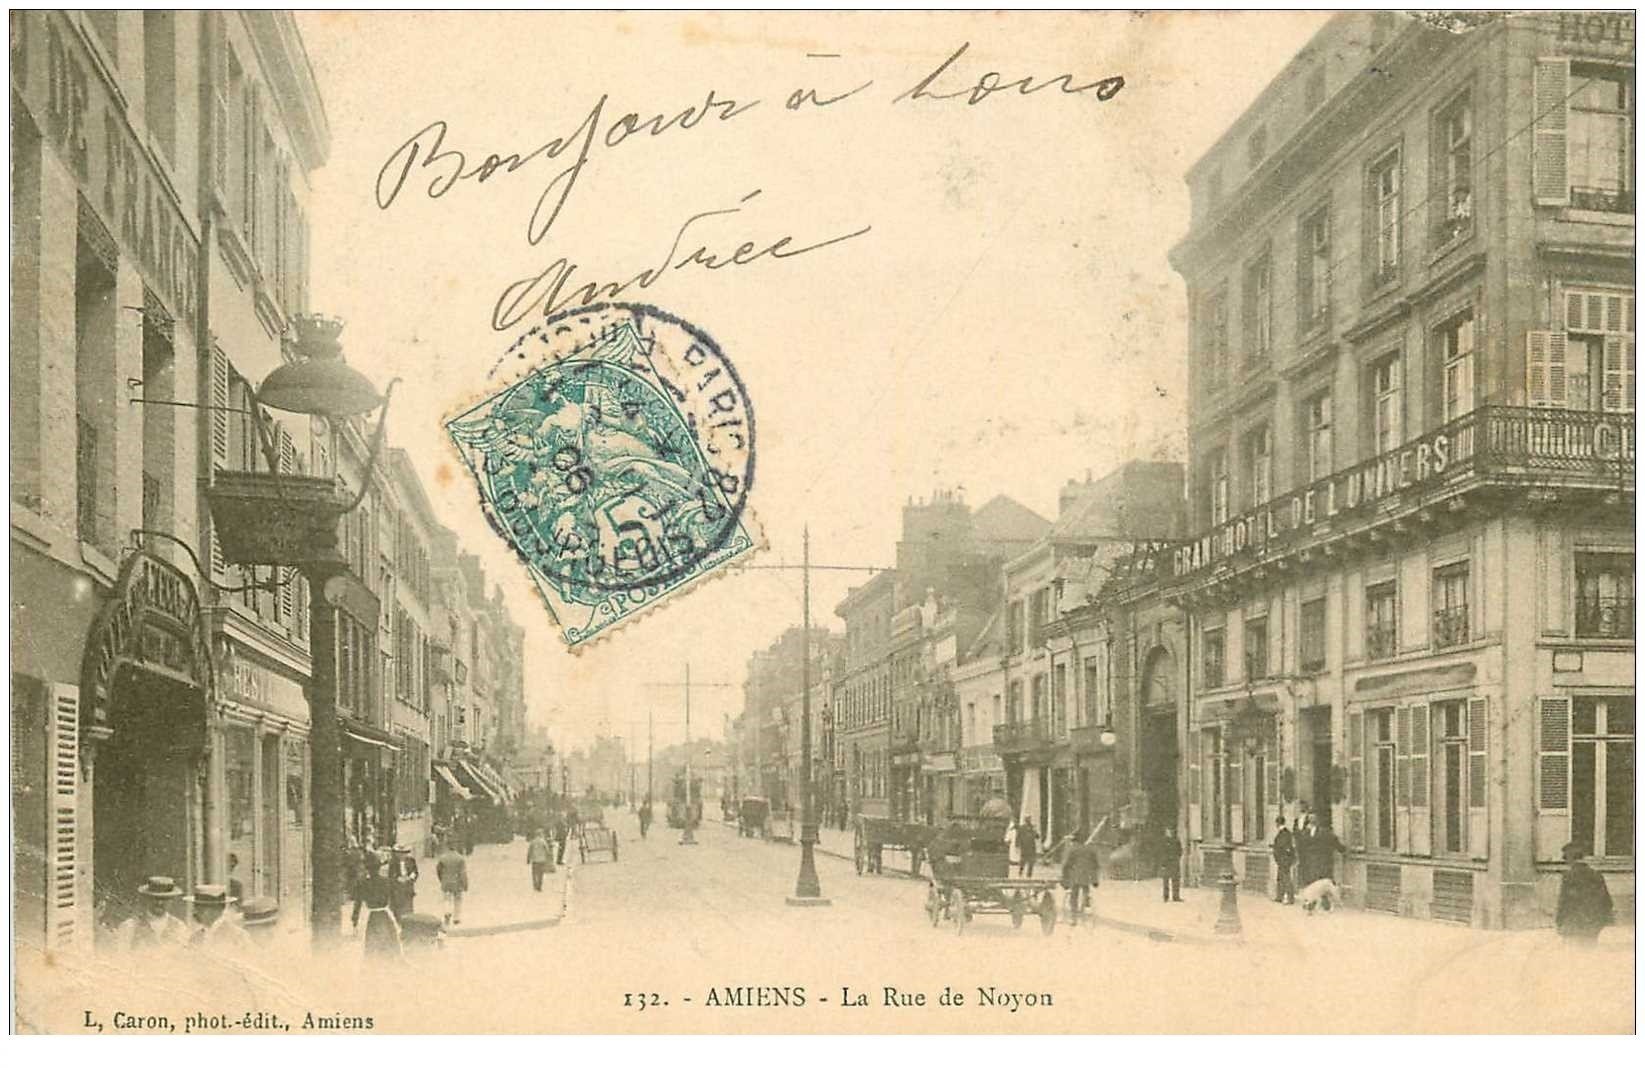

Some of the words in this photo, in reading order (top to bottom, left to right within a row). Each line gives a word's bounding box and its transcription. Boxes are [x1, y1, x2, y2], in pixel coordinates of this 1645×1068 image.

[376, 93, 760, 246] Bonjour
[491, 188, 873, 332] Andrée
[1291, 489, 1316, 529] DE
